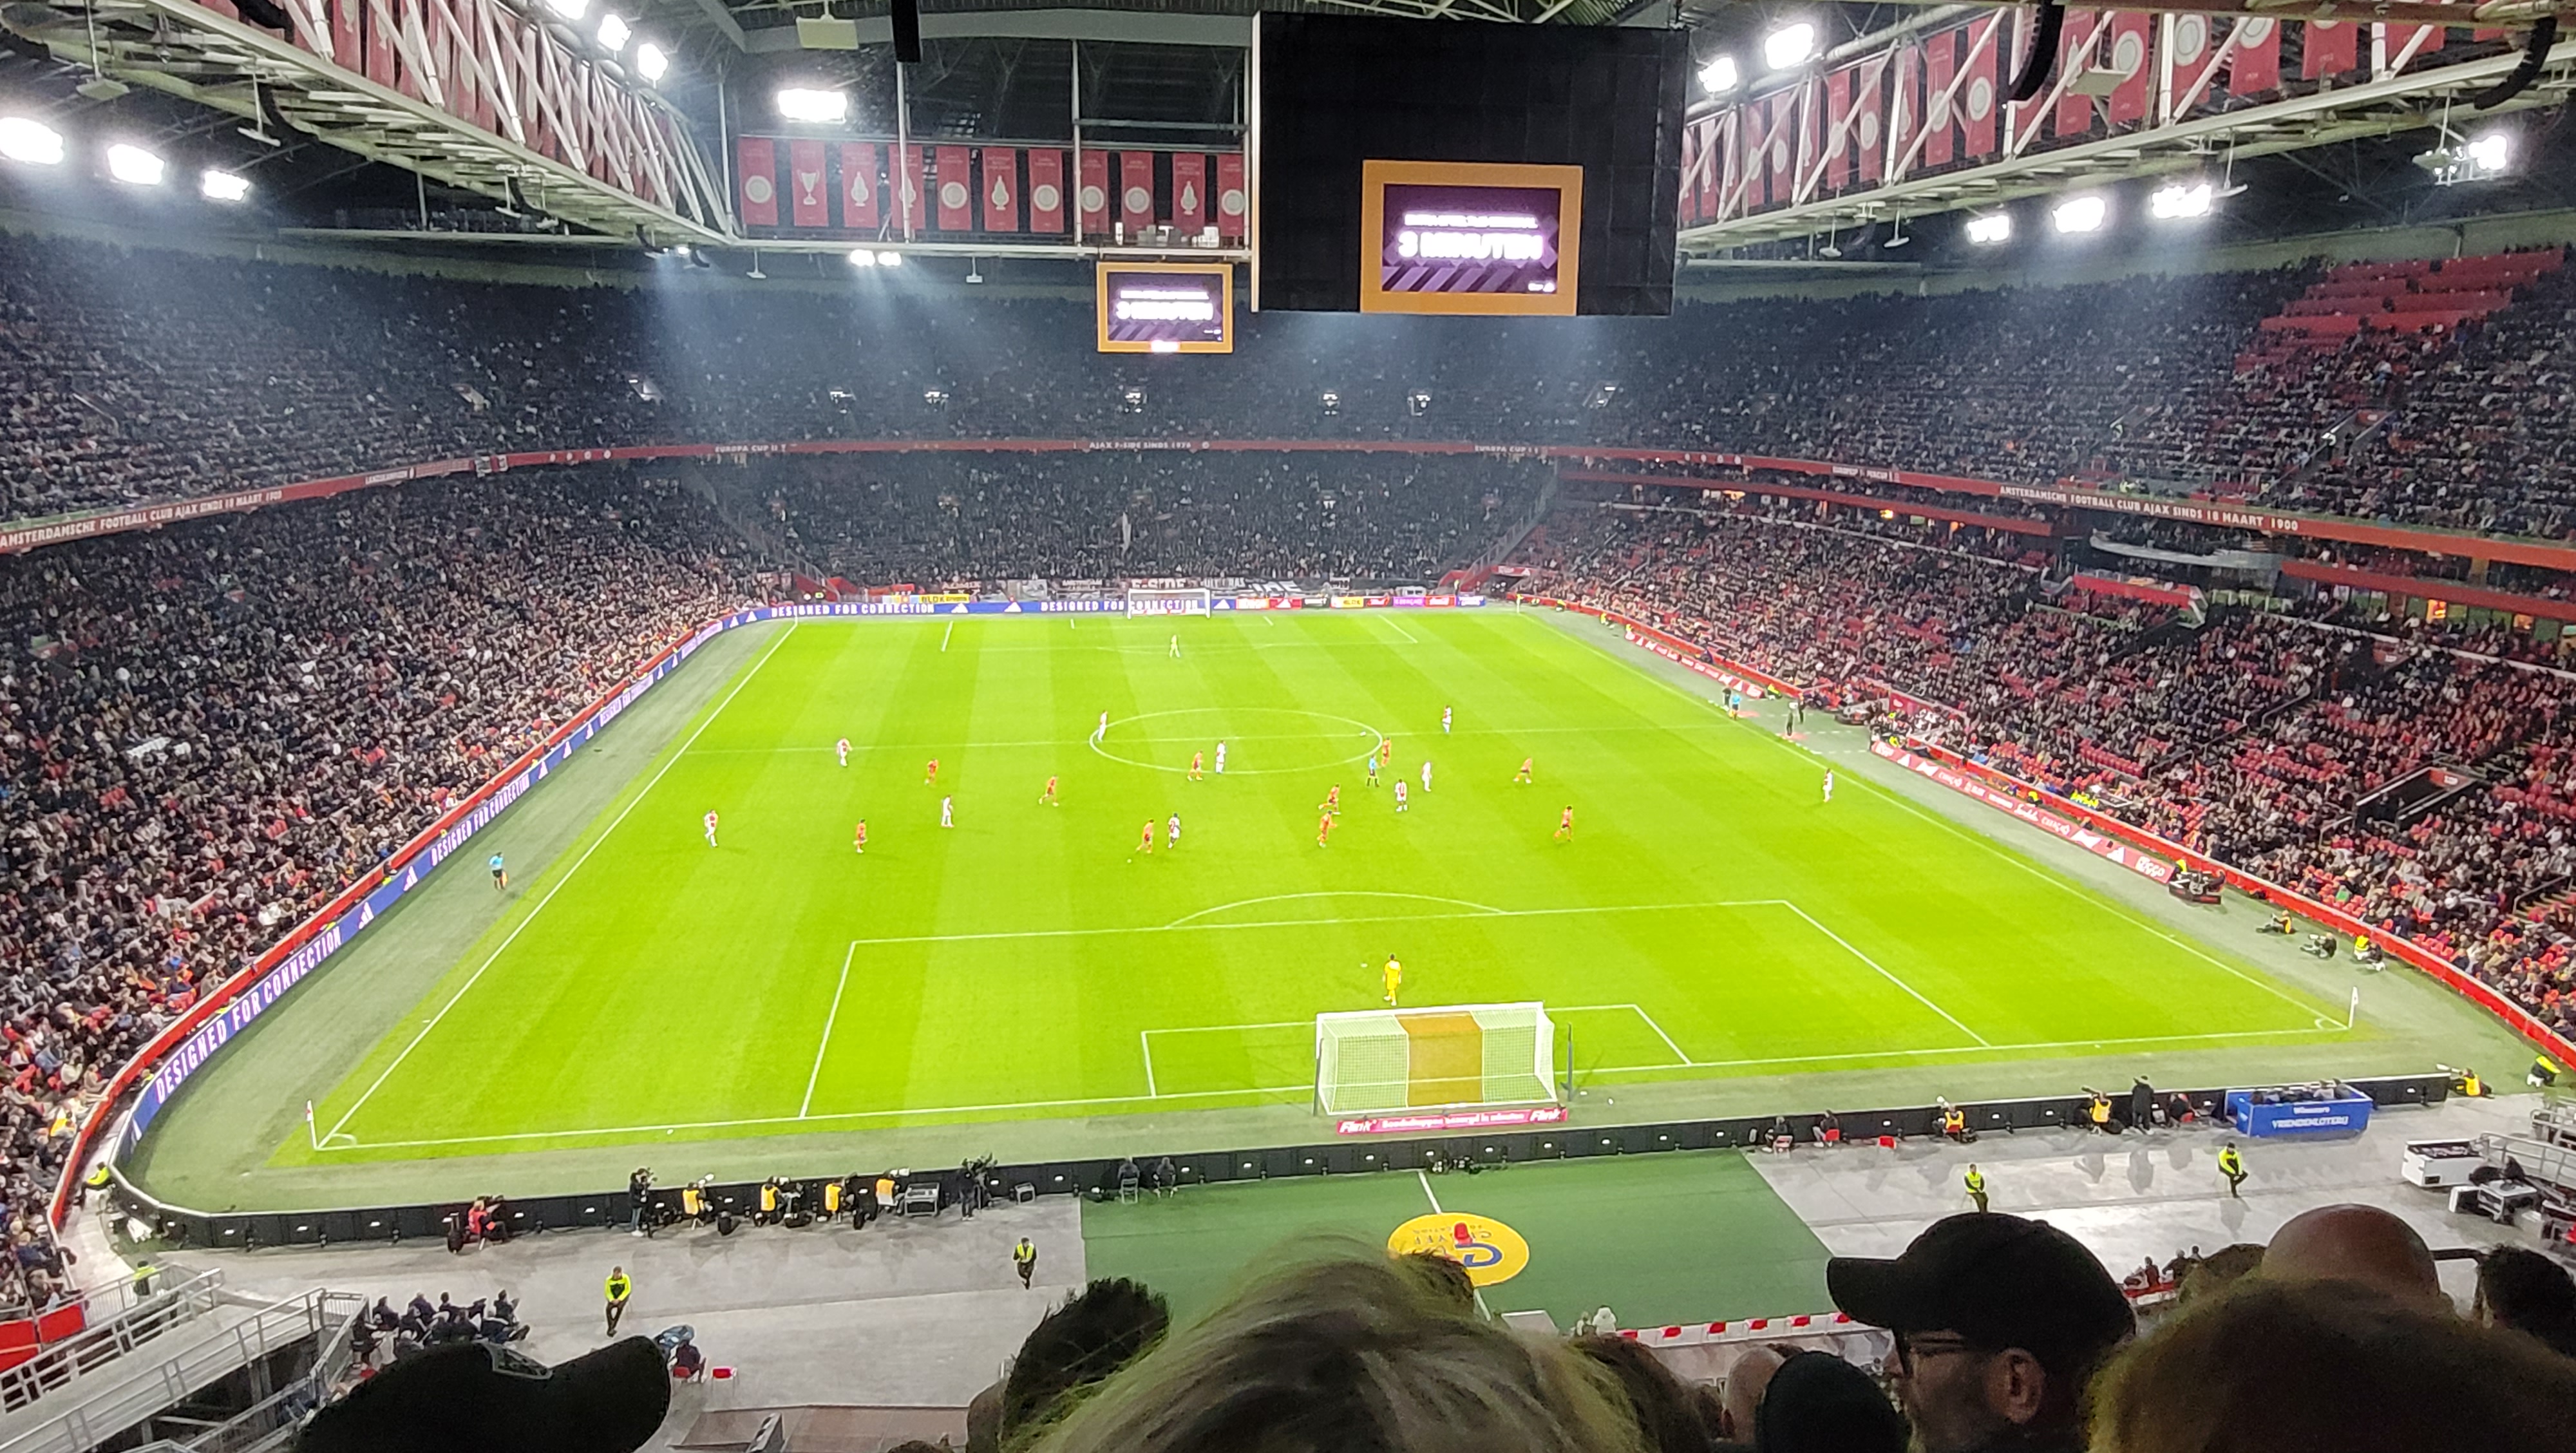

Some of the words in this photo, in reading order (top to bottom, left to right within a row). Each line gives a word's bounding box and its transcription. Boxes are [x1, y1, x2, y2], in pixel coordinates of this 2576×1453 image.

[1089, 441, 1112, 450] AJAX
[0, 520, 96, 547] AMSTERDAMSCHE
[100, 512, 147, 531] FOOTBALL
[149, 506, 173, 522] CLUB
[175, 504, 198, 518] AJAX
[200, 500, 223, 513] SINDS
[236, 493, 263, 506] MAART
[2000, 486, 2067, 502] AMSTERDAMSCHE
[2070, 494, 2114, 509] FOOTBALL
[2117, 499, 2141, 511] CLUB
[2143, 503, 2170, 516] AJAX
[2173, 506, 2202, 519] SINDS
[2206, 510, 2219, 520] 18
[2222, 511, 2264, 526] MAART
[2271, 517, 2299, 531] 1900
[771, 604, 830, 618] DESIGNED
[835, 603, 857, 615] FOR
[862, 603, 934, 614] CONNECTION
[1040, 601, 1101, 611] DESIGNED
[1103, 600, 1124, 611] FOR
[431, 820, 472, 866] DESIGNED
[473, 805, 490, 831] FOR
[155, 1018, 227, 1105] DESIGNED
[232, 991, 261, 1030] FOR
[263, 925, 342, 1004] CONNECTION
